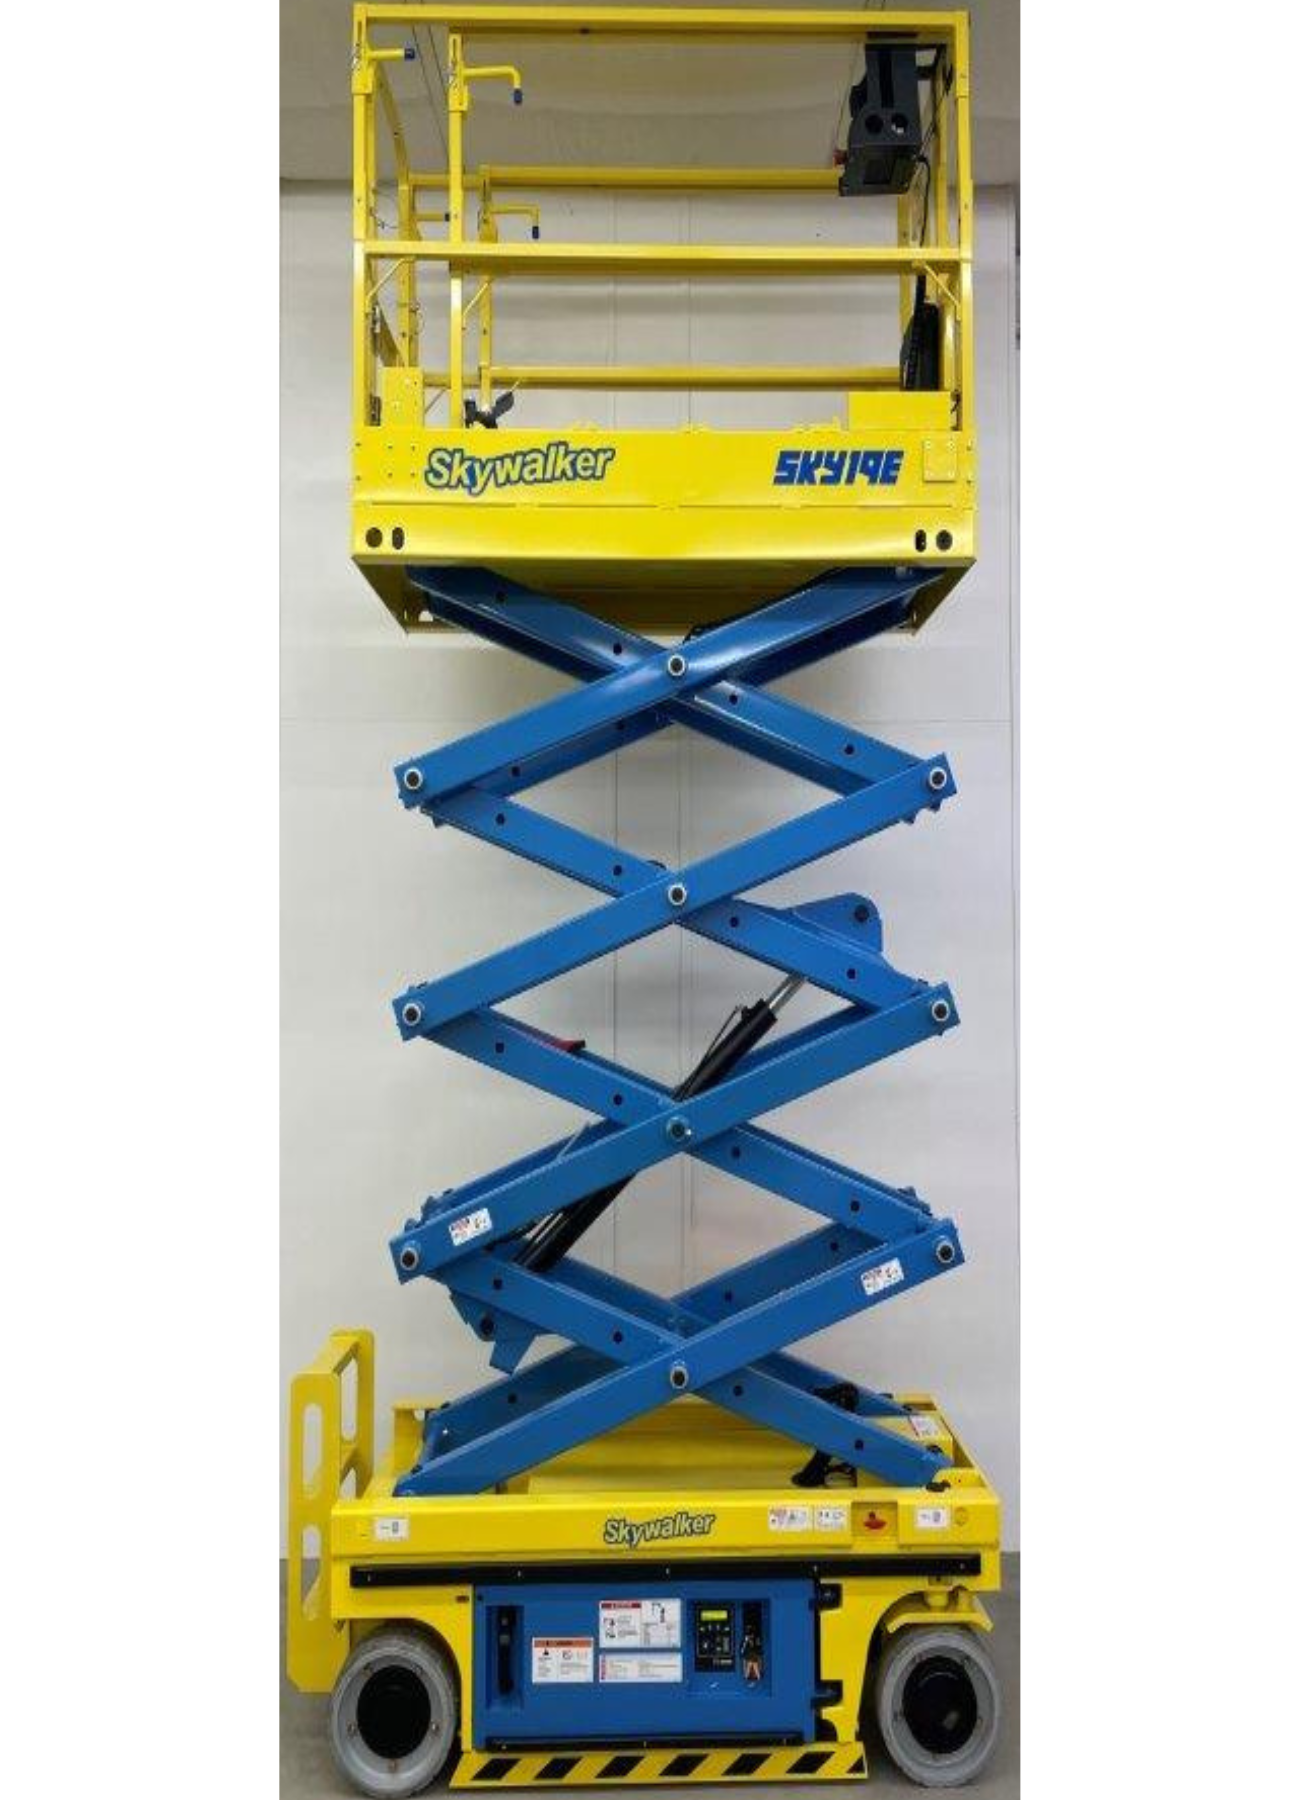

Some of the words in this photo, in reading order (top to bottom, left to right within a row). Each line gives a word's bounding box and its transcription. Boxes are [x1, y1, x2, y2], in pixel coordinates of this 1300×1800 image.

[425, 441, 616, 497] Skywalker
[773, 450, 904, 485] SKY19E
[603, 1511, 716, 1548] Skywalker
